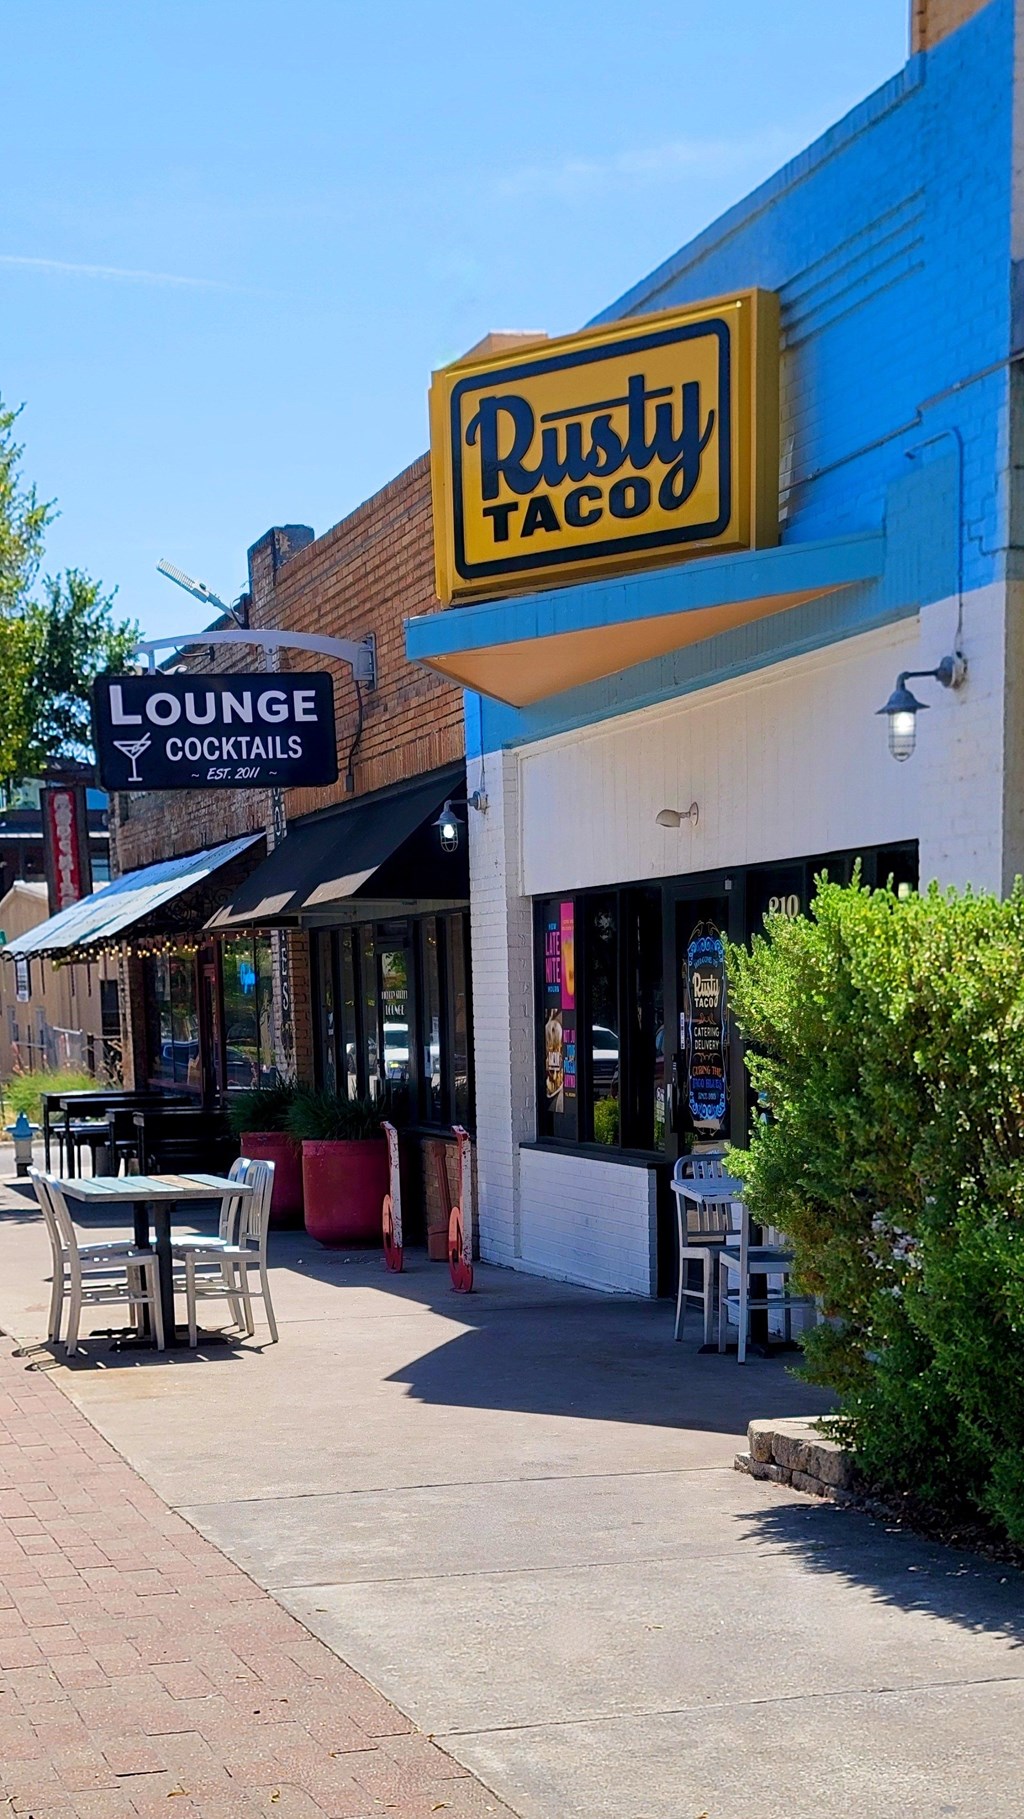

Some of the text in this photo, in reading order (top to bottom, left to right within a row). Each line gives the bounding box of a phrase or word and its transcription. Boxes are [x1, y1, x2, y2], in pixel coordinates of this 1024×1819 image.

[465, 374, 715, 511] Rusty
[483, 476, 651, 542] TACO
[108, 684, 318, 726] LOUNGE
[165, 735, 303, 762] COCKTAILS
[206, 766, 260, 780] EST. 2011
[545, 931, 560, 956] LATE
[545, 957, 561, 984] NITE
[692, 972, 719, 1007] Rusty
[694, 997, 714, 1008] TACO
[694, 1027, 719, 1037] CATERING
[695, 1040, 719, 1050] DELIVERY
